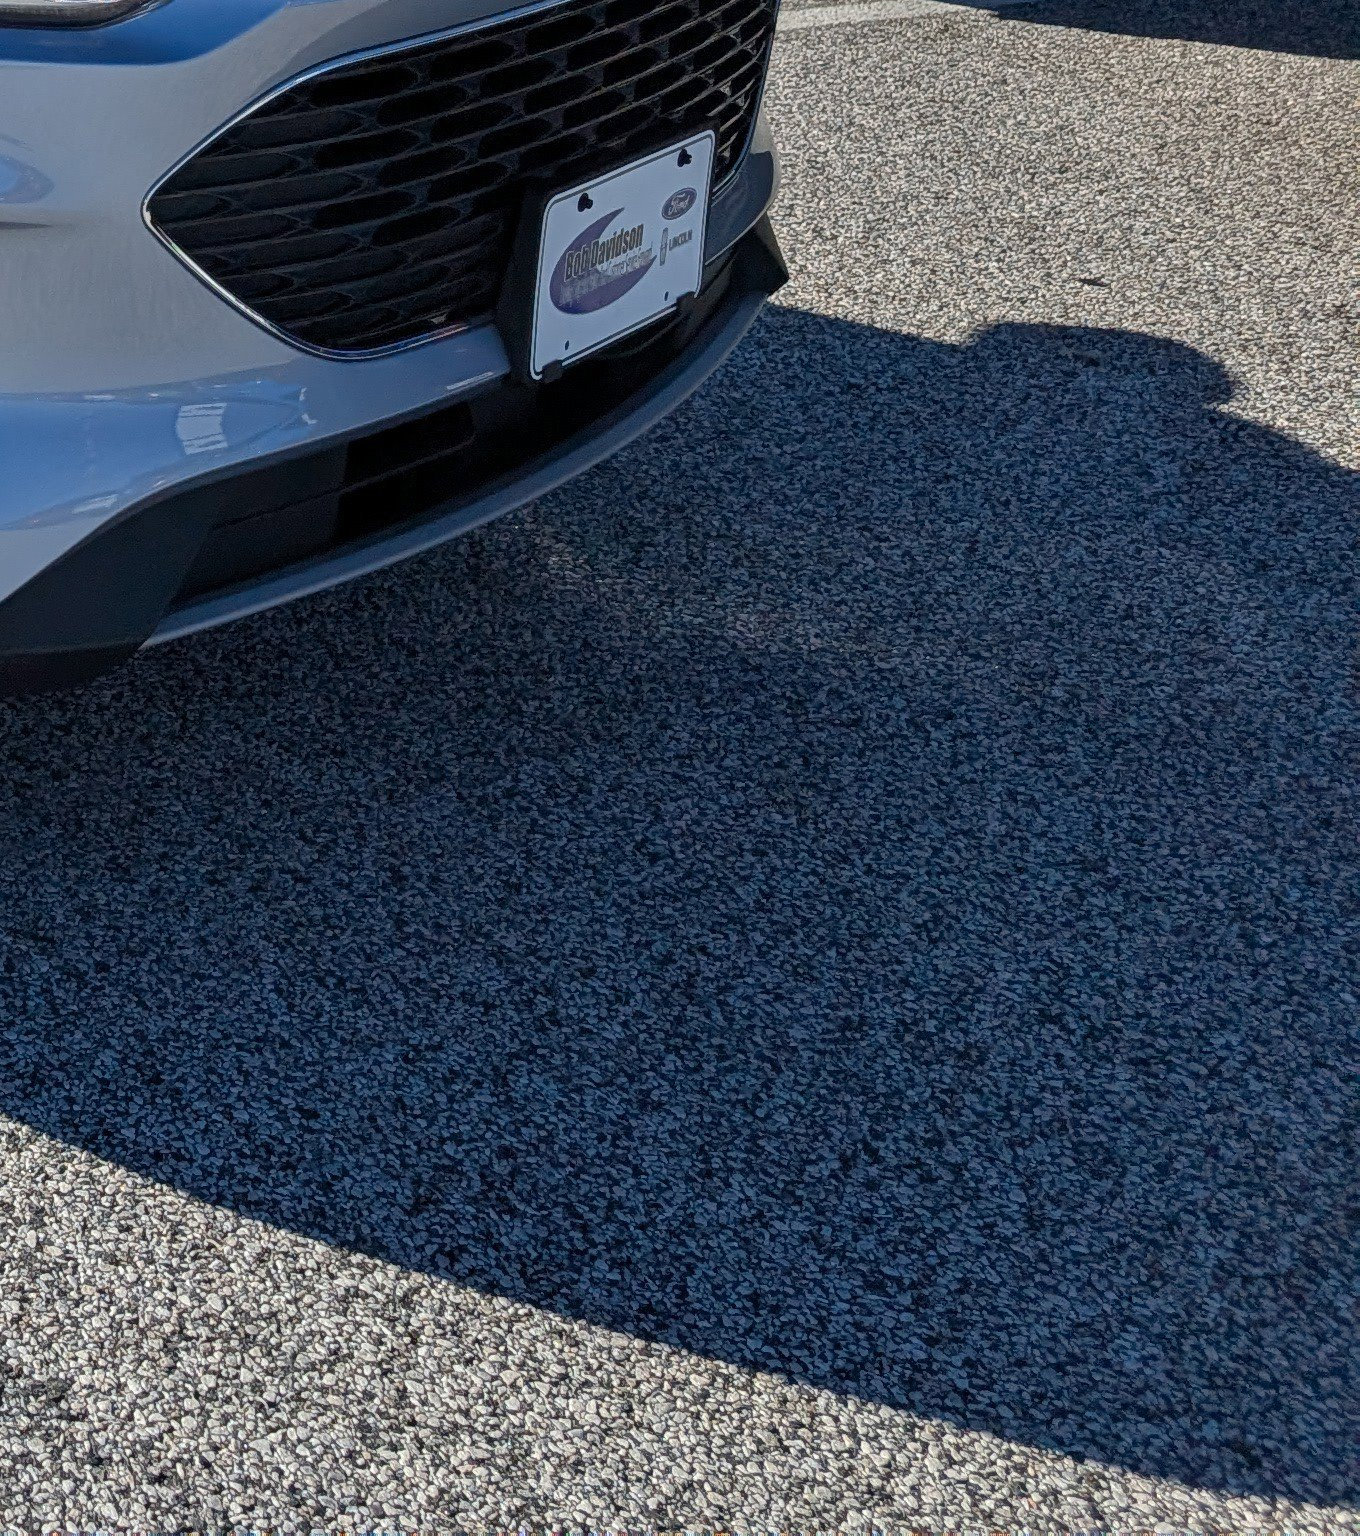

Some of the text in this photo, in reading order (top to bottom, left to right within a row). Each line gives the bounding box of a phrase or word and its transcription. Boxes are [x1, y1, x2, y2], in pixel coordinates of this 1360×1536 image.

[667, 193, 692, 216] Ford
[564, 243, 591, 282] Bob
[589, 224, 645, 270] Davidson
